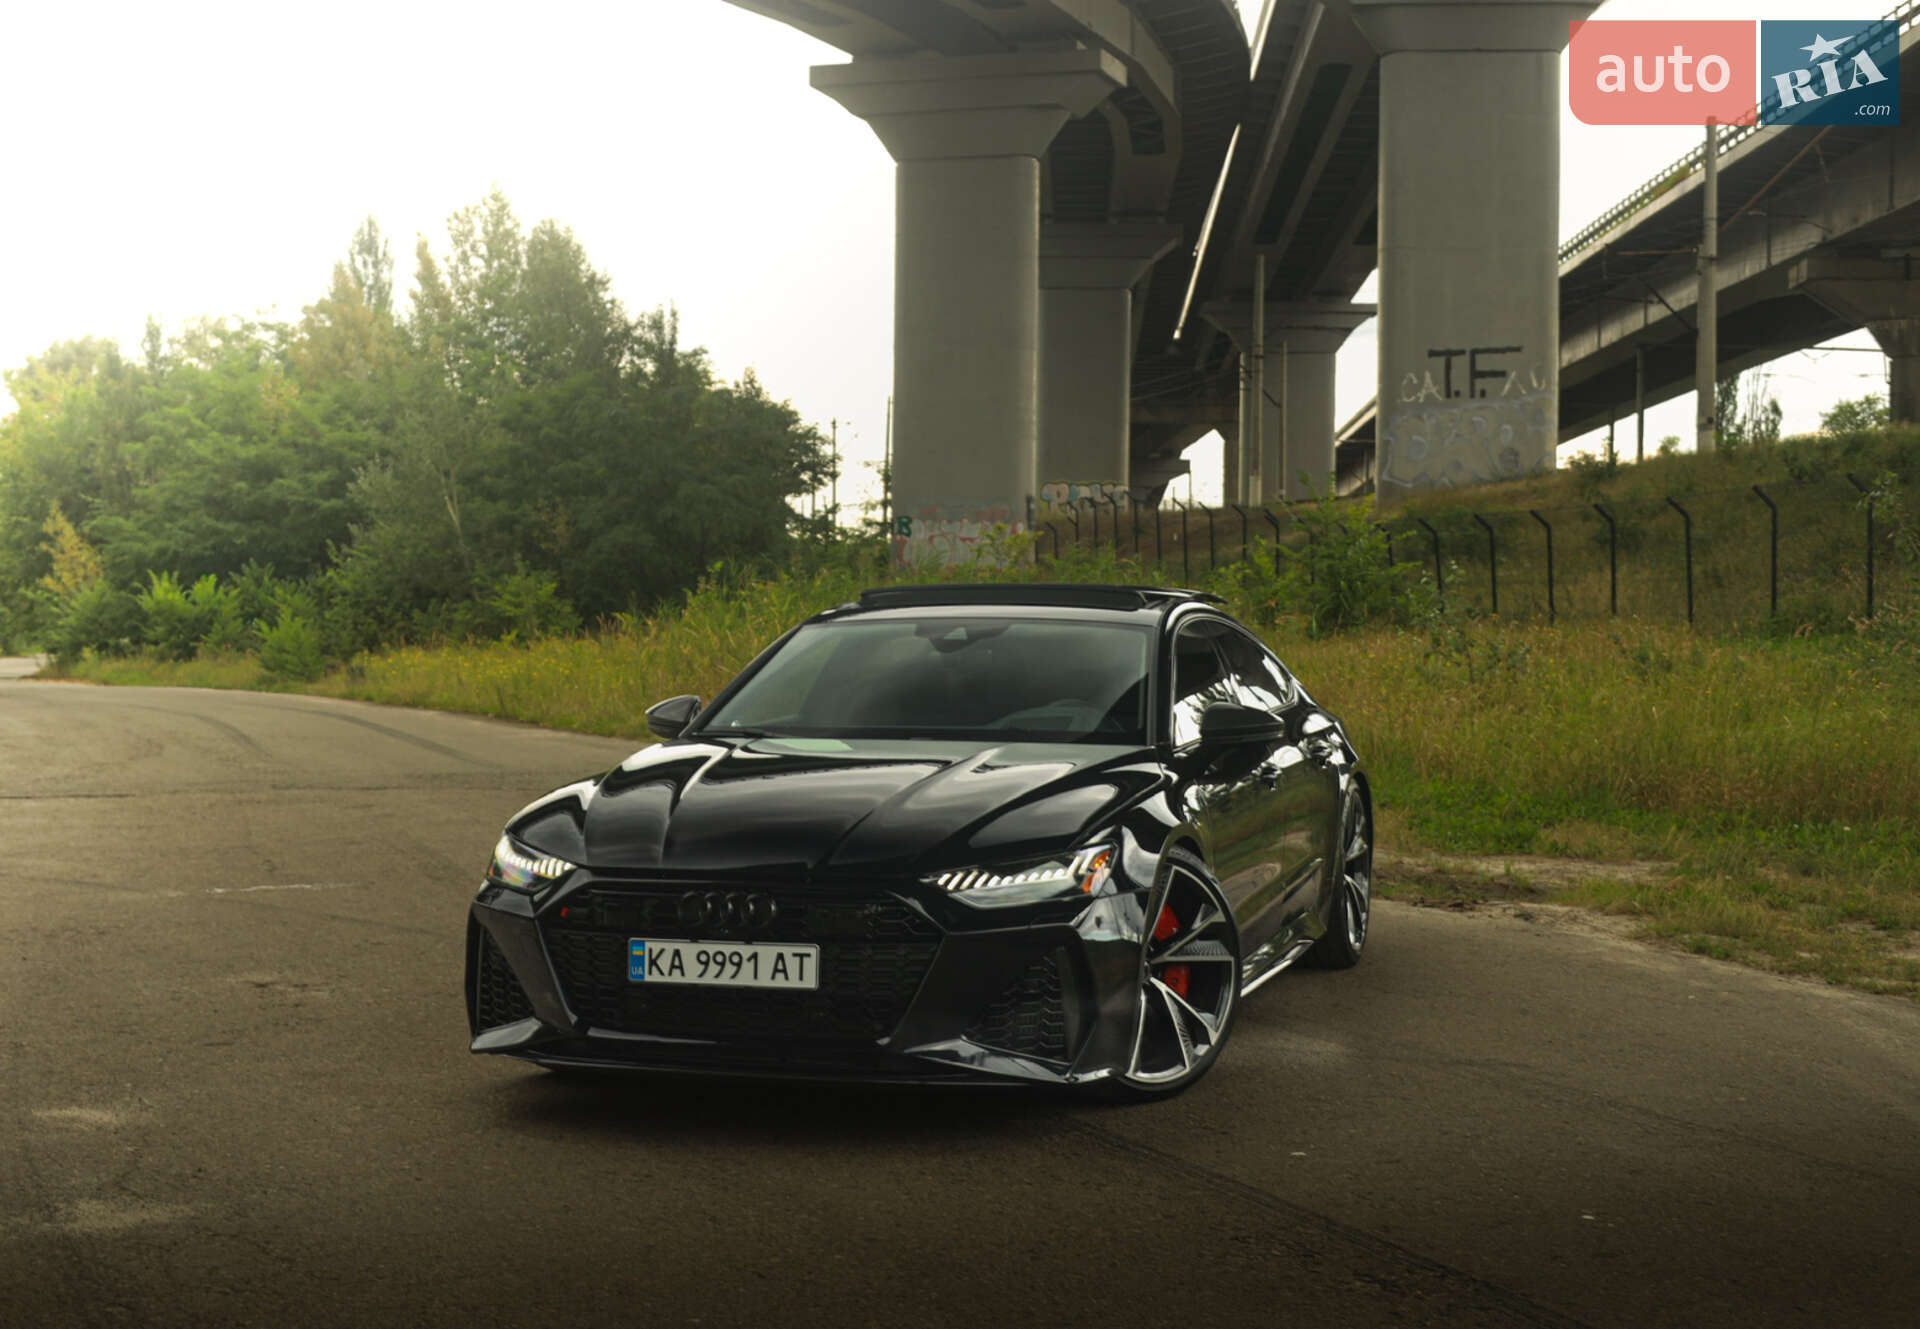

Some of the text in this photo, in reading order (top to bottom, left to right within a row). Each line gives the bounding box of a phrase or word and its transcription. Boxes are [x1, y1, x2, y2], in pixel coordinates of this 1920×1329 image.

[631, 965, 644, 976] UA
[647, 947, 812, 981] KA 9991 AT
